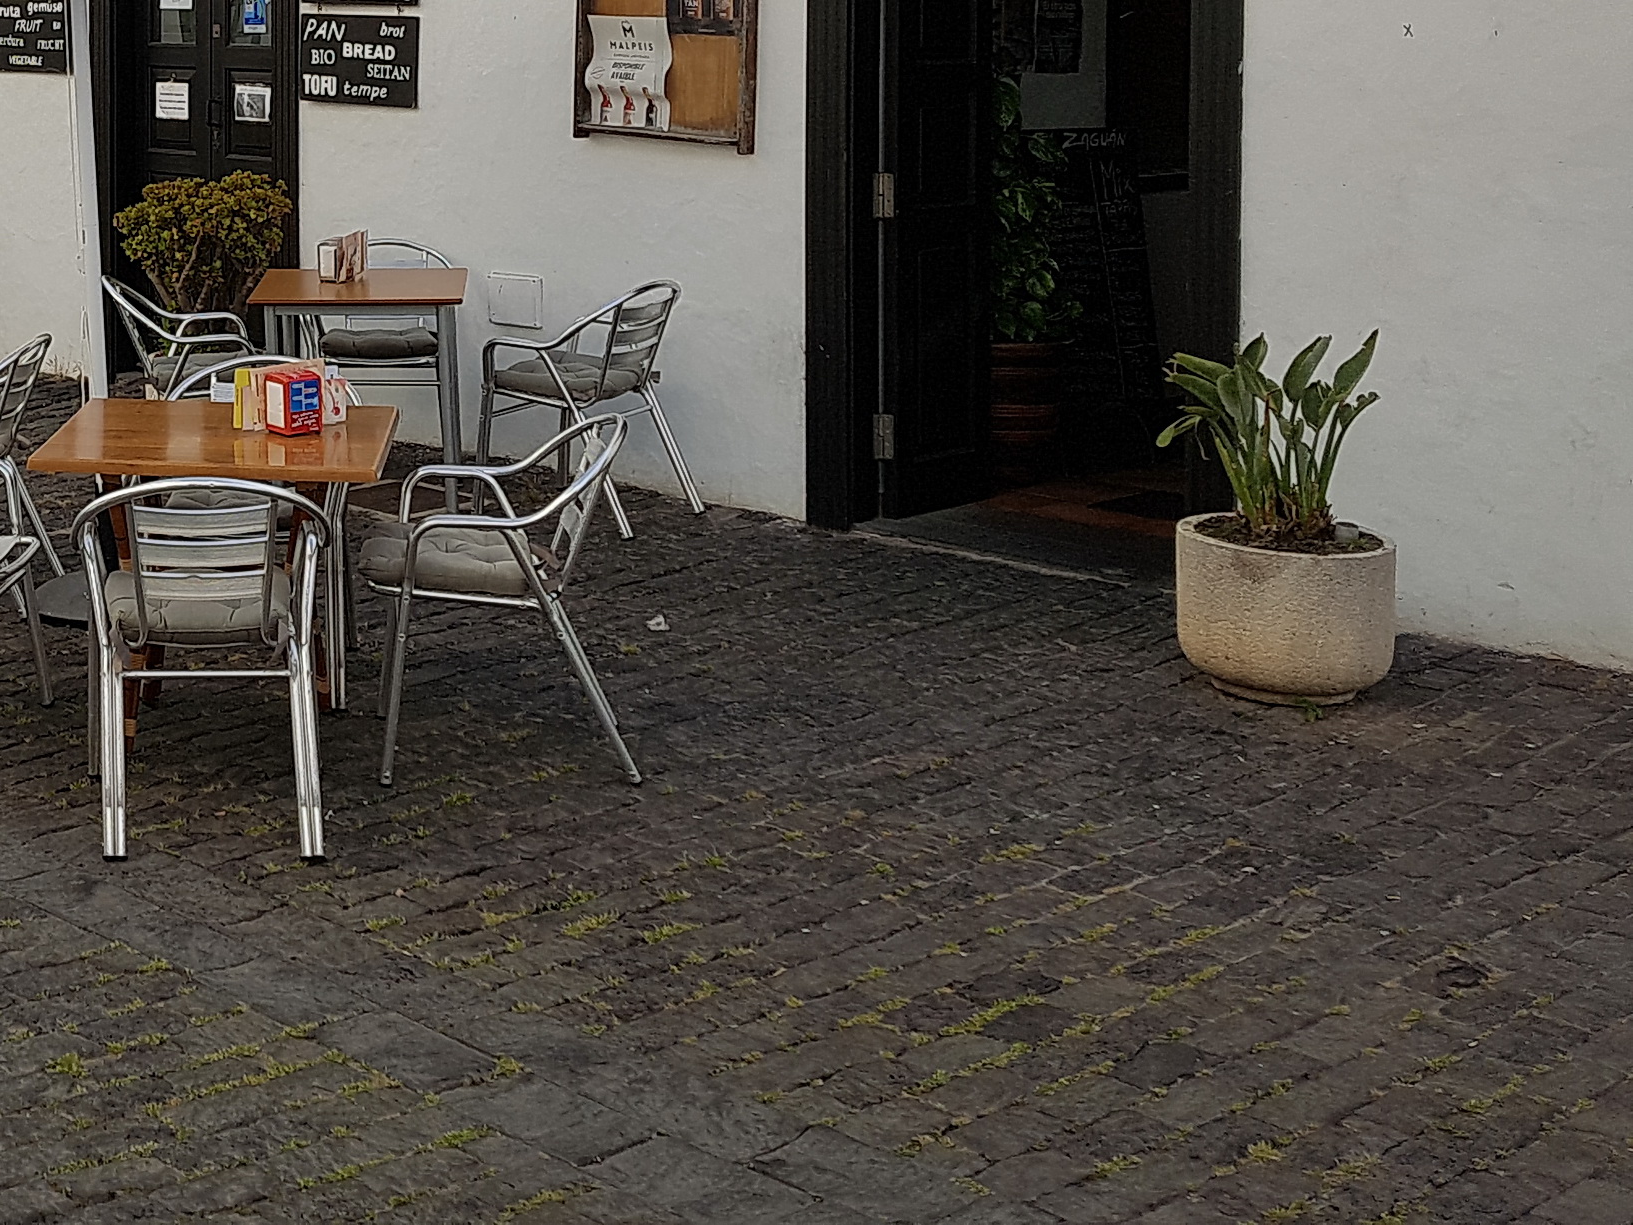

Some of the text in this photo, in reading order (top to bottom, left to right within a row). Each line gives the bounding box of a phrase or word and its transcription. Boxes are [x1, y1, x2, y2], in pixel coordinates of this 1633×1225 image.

[14, 19, 43, 33] FRUIT
[303, 18, 346, 42] PAN
[379, 21, 406, 38] brot
[342, 41, 396, 61] BREAD
[609, 40, 654, 52] MALPEIS
[8, 55, 43, 66] VEGETABLE
[310, 48, 336, 65] BIO
[367, 63, 411, 81] SEITAN
[303, 73, 388, 102] TOFU tempe
